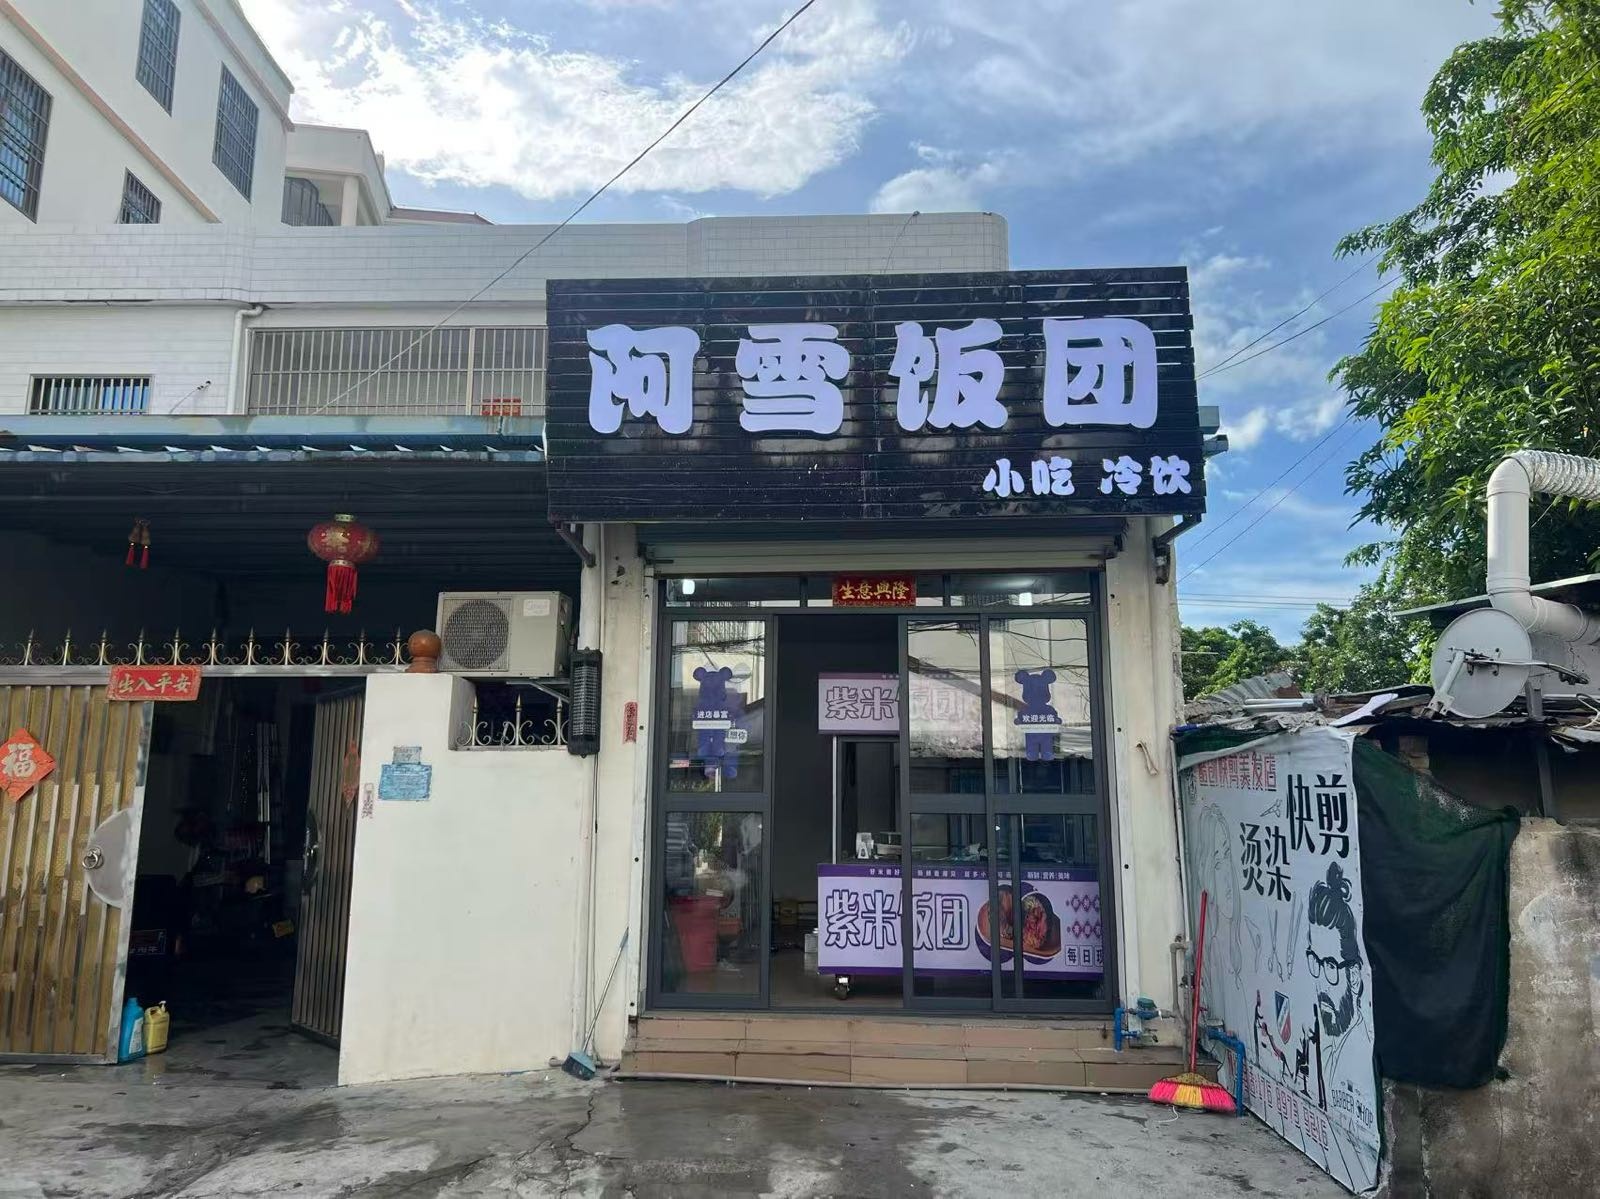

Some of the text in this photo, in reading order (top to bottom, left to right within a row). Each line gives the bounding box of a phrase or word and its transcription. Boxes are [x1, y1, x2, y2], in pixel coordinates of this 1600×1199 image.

[586, 317, 1158, 435] 阿雪饭团
[982, 454, 1192, 497] 小吃 冷饮
[118, 671, 191, 694] 出入平安
[696, 710, 729, 719] 进店暴富
[1022, 713, 1055, 723] 欢迎光临
[1, 743, 36, 778] 福
[1286, 774, 1349, 858] 快剪
[1240, 822, 1291, 902] 烫染
[825, 889, 970, 951] 紫米饭团
[1331, 1089, 1374, 1128] BARBER SHOP
